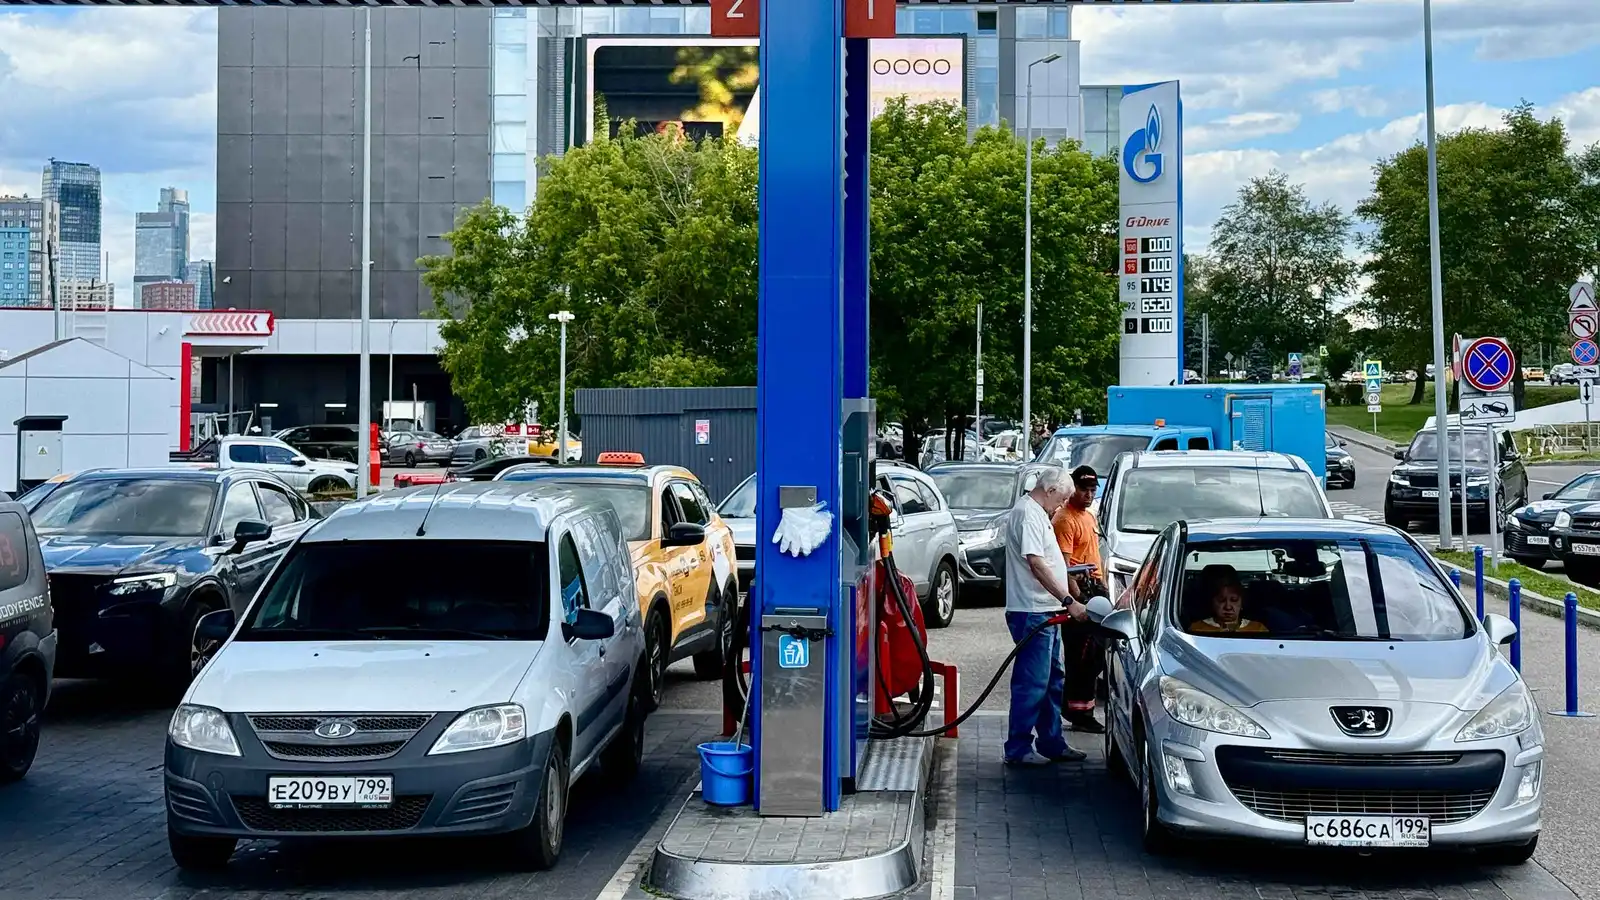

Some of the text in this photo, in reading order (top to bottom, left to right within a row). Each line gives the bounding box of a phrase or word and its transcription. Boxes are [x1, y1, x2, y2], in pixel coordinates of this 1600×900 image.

[1127, 263, 1136, 272] 95
[1127, 281, 1136, 291] 95
[0, 594, 45, 619] ODYFENCE
[357, 779, 386, 794] 799
[1395, 819, 1424, 833] 199
